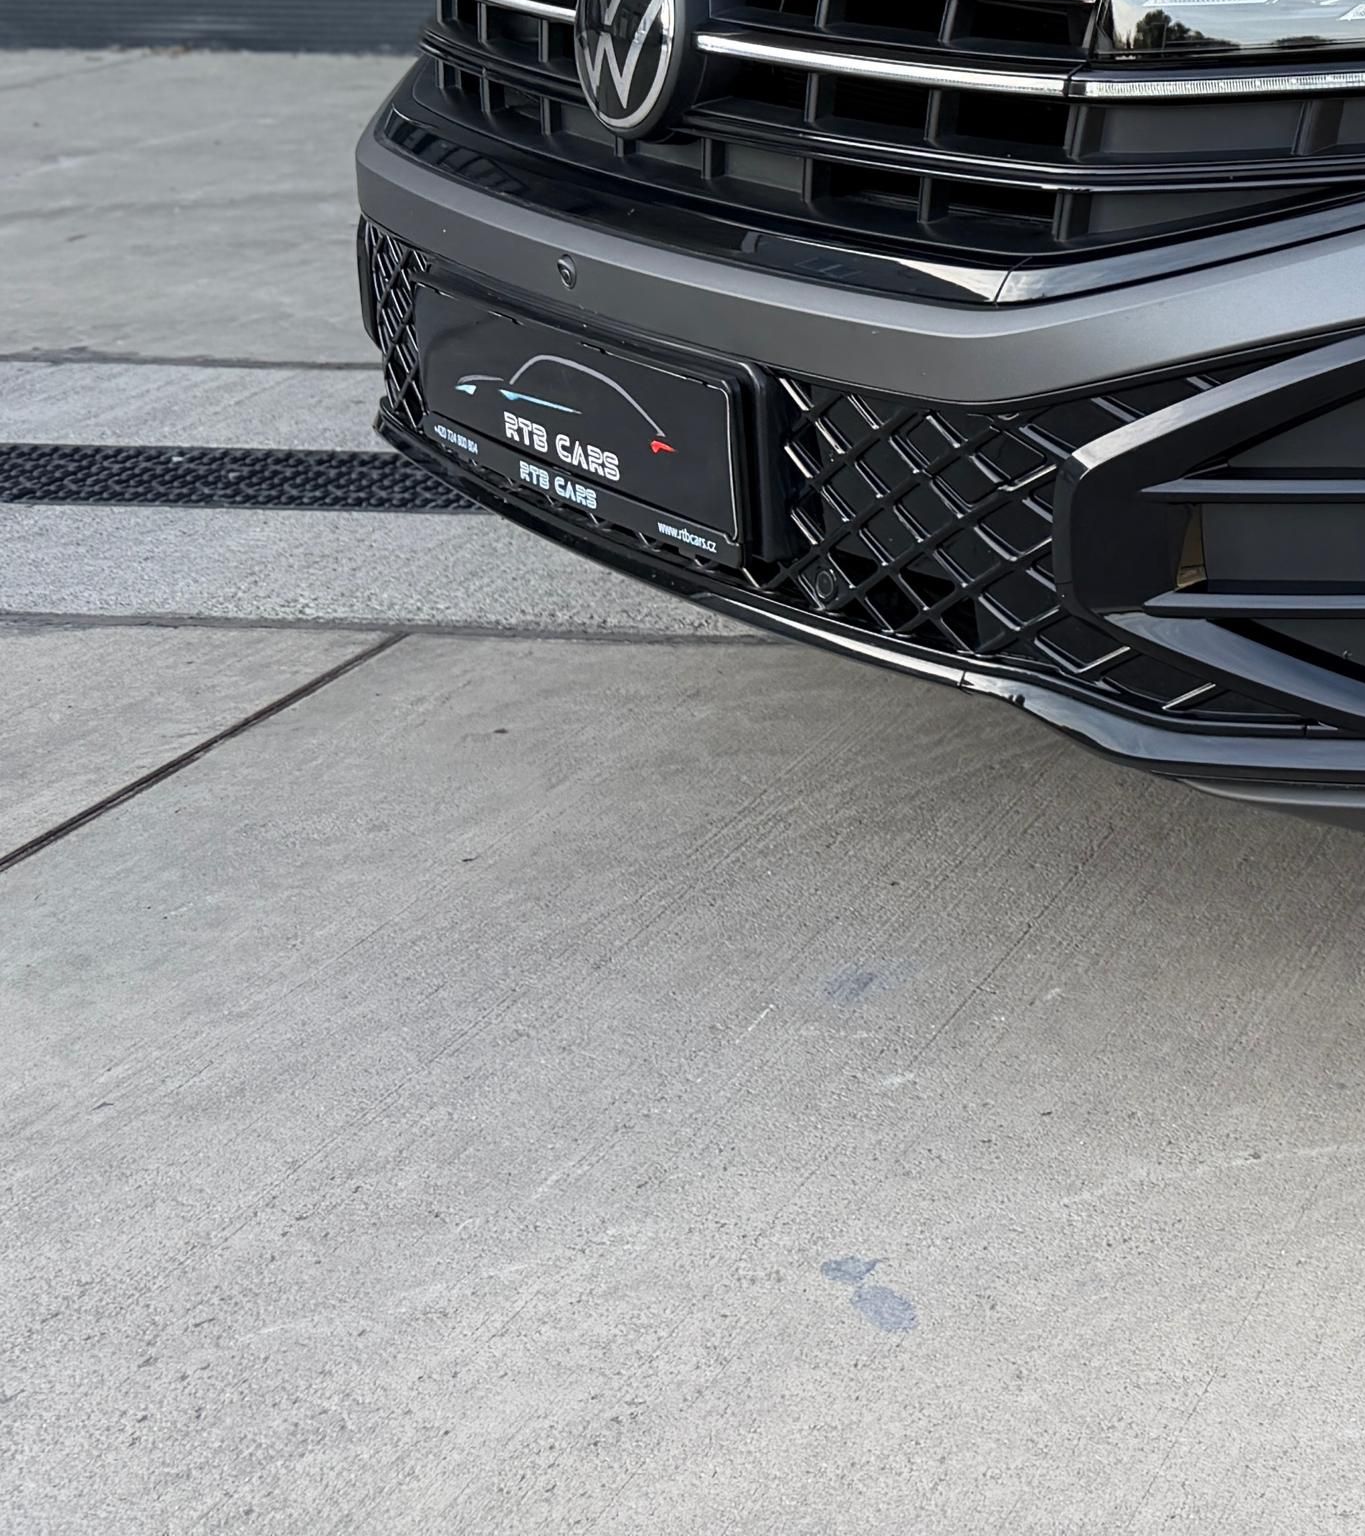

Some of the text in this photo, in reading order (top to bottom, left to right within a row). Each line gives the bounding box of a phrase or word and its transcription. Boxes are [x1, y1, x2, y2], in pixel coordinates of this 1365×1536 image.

[503, 411, 620, 481] RTB CARS
[519, 460, 597, 510] RTB CARS
[657, 522, 718, 554] www.rtbcars.cz
